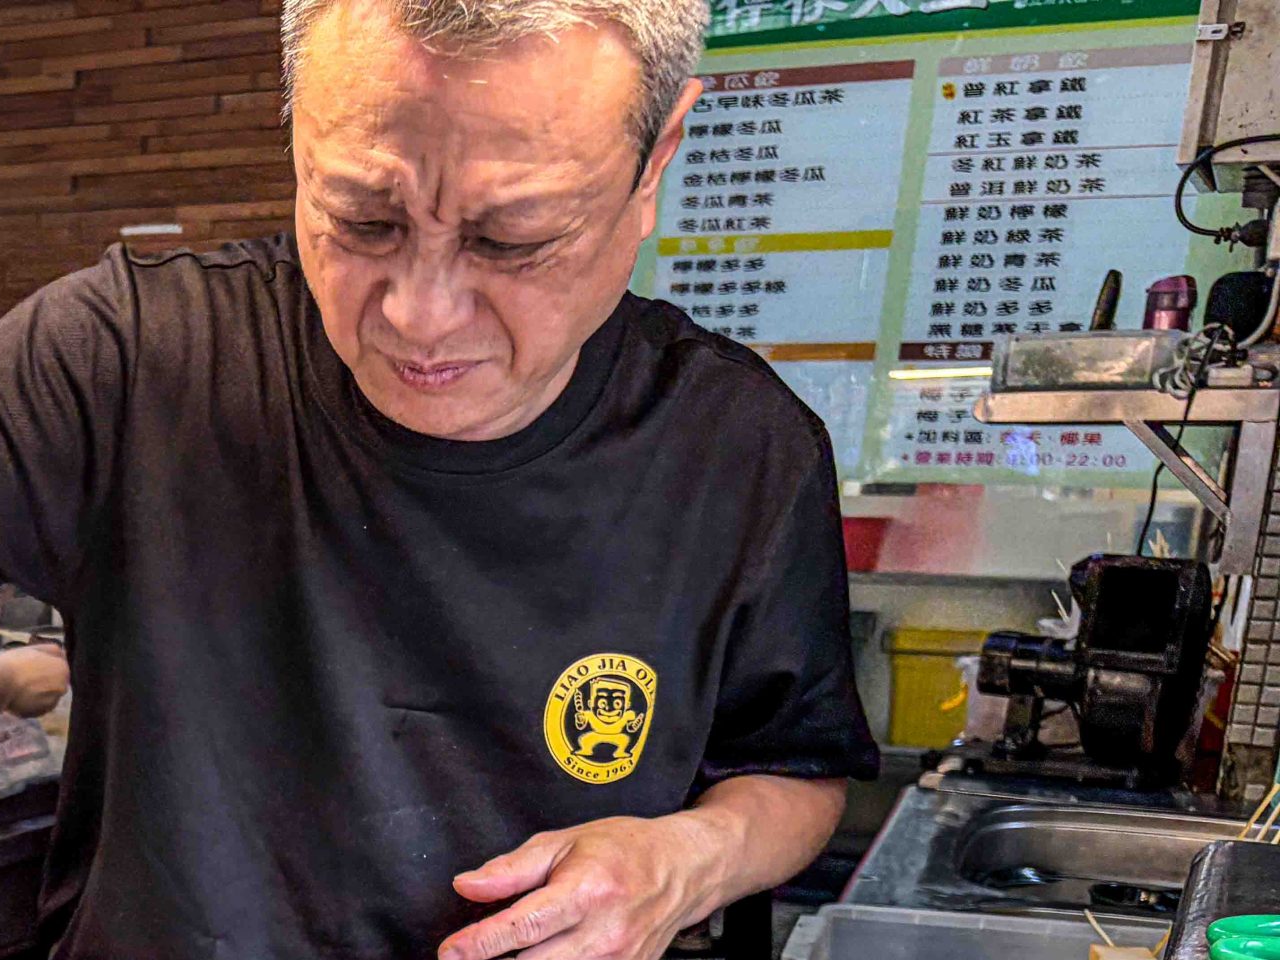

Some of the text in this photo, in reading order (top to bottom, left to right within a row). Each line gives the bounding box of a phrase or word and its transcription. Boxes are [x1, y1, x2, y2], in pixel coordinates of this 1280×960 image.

[692, 88, 845, 113] 古早味冬瓜茶
[682, 303, 760, 319] 桔多多
[555, 658, 655, 702] LIAO JIA OL
[564, 757, 600, 779] Since
